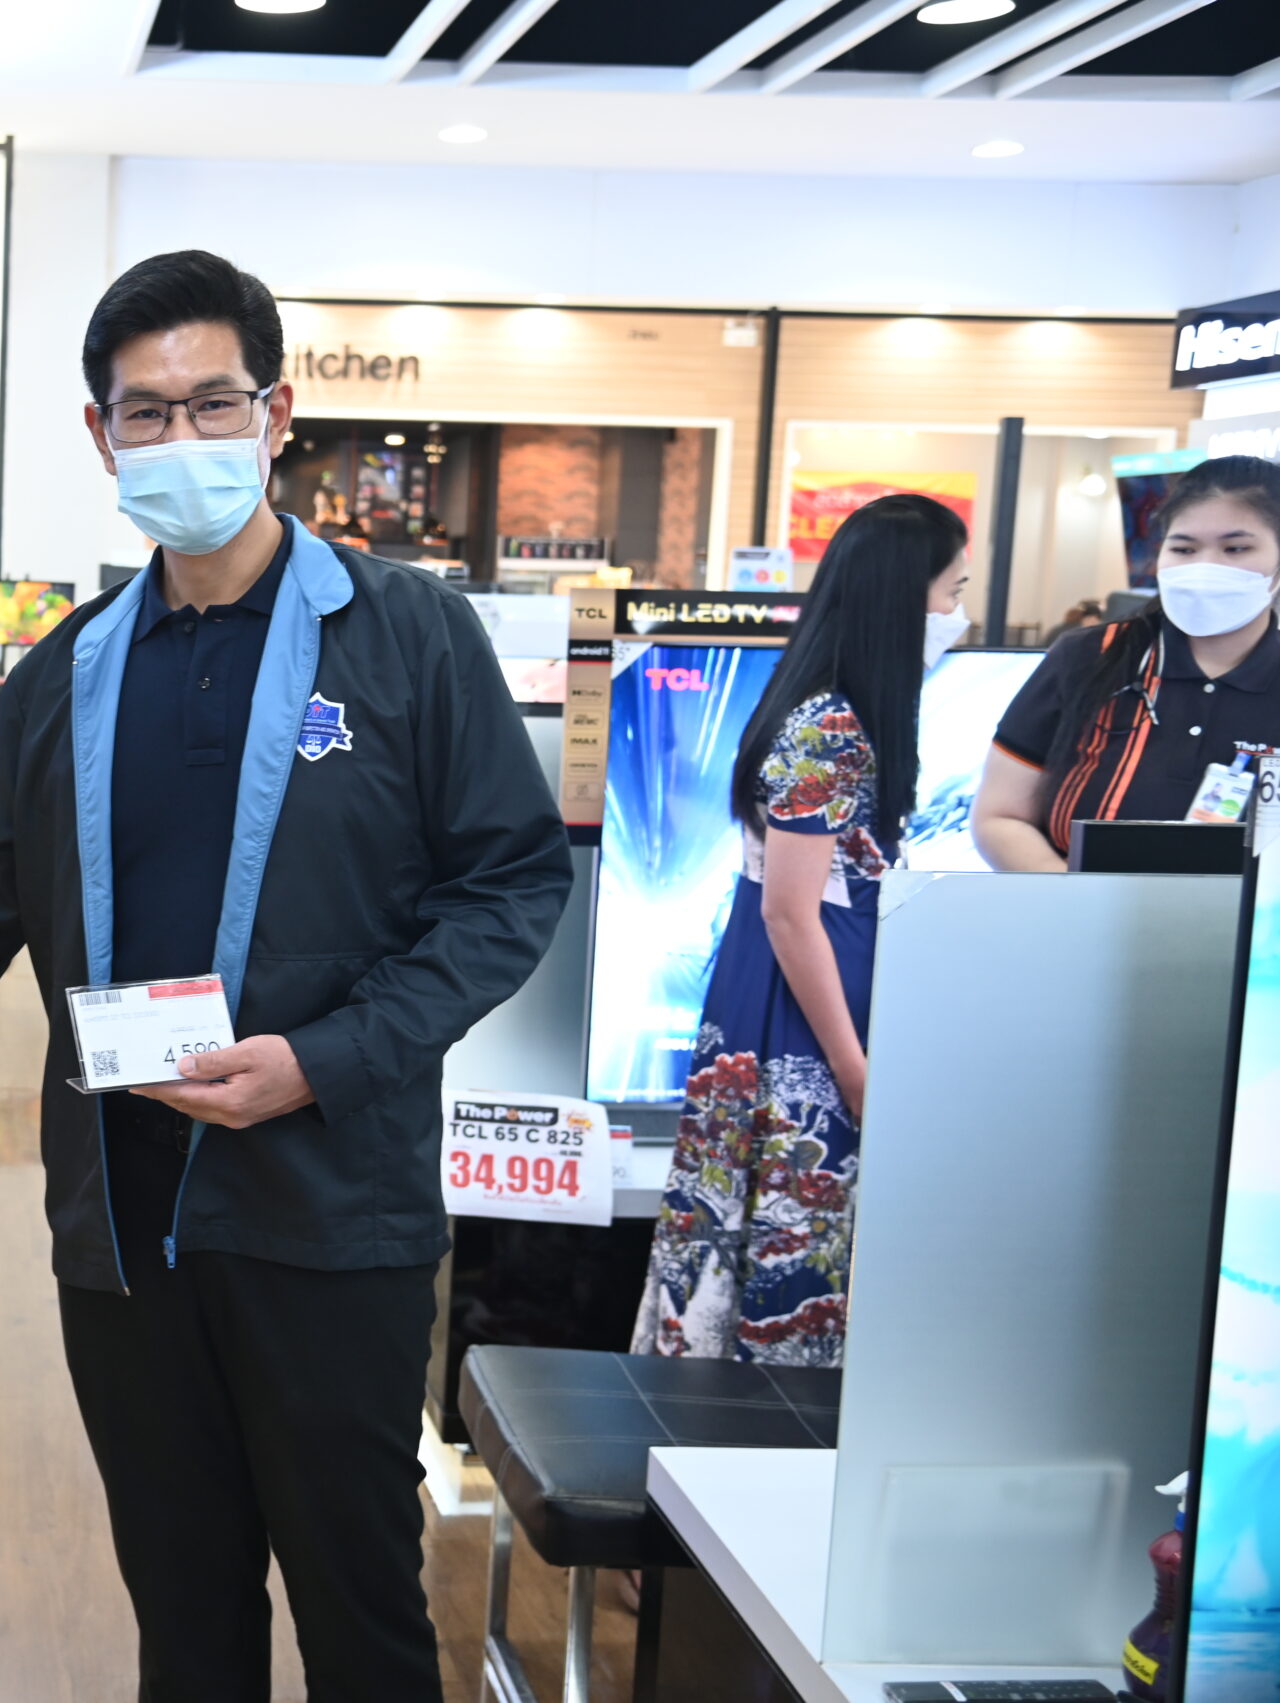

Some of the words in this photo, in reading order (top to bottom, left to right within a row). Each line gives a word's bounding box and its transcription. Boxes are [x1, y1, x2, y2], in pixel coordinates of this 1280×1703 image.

[283, 343, 420, 381] itchen
[789, 515, 844, 540] CLE
[575, 607, 608, 619] TCL
[627, 600, 675, 623] Mini
[645, 667, 709, 692] TCL
[449, 1122, 488, 1140] TCL
[495, 1126, 519, 1142] 65
[525, 1128, 540, 1144] C
[546, 1130, 584, 1147] 825
[449, 1151, 580, 1197] 34,994
